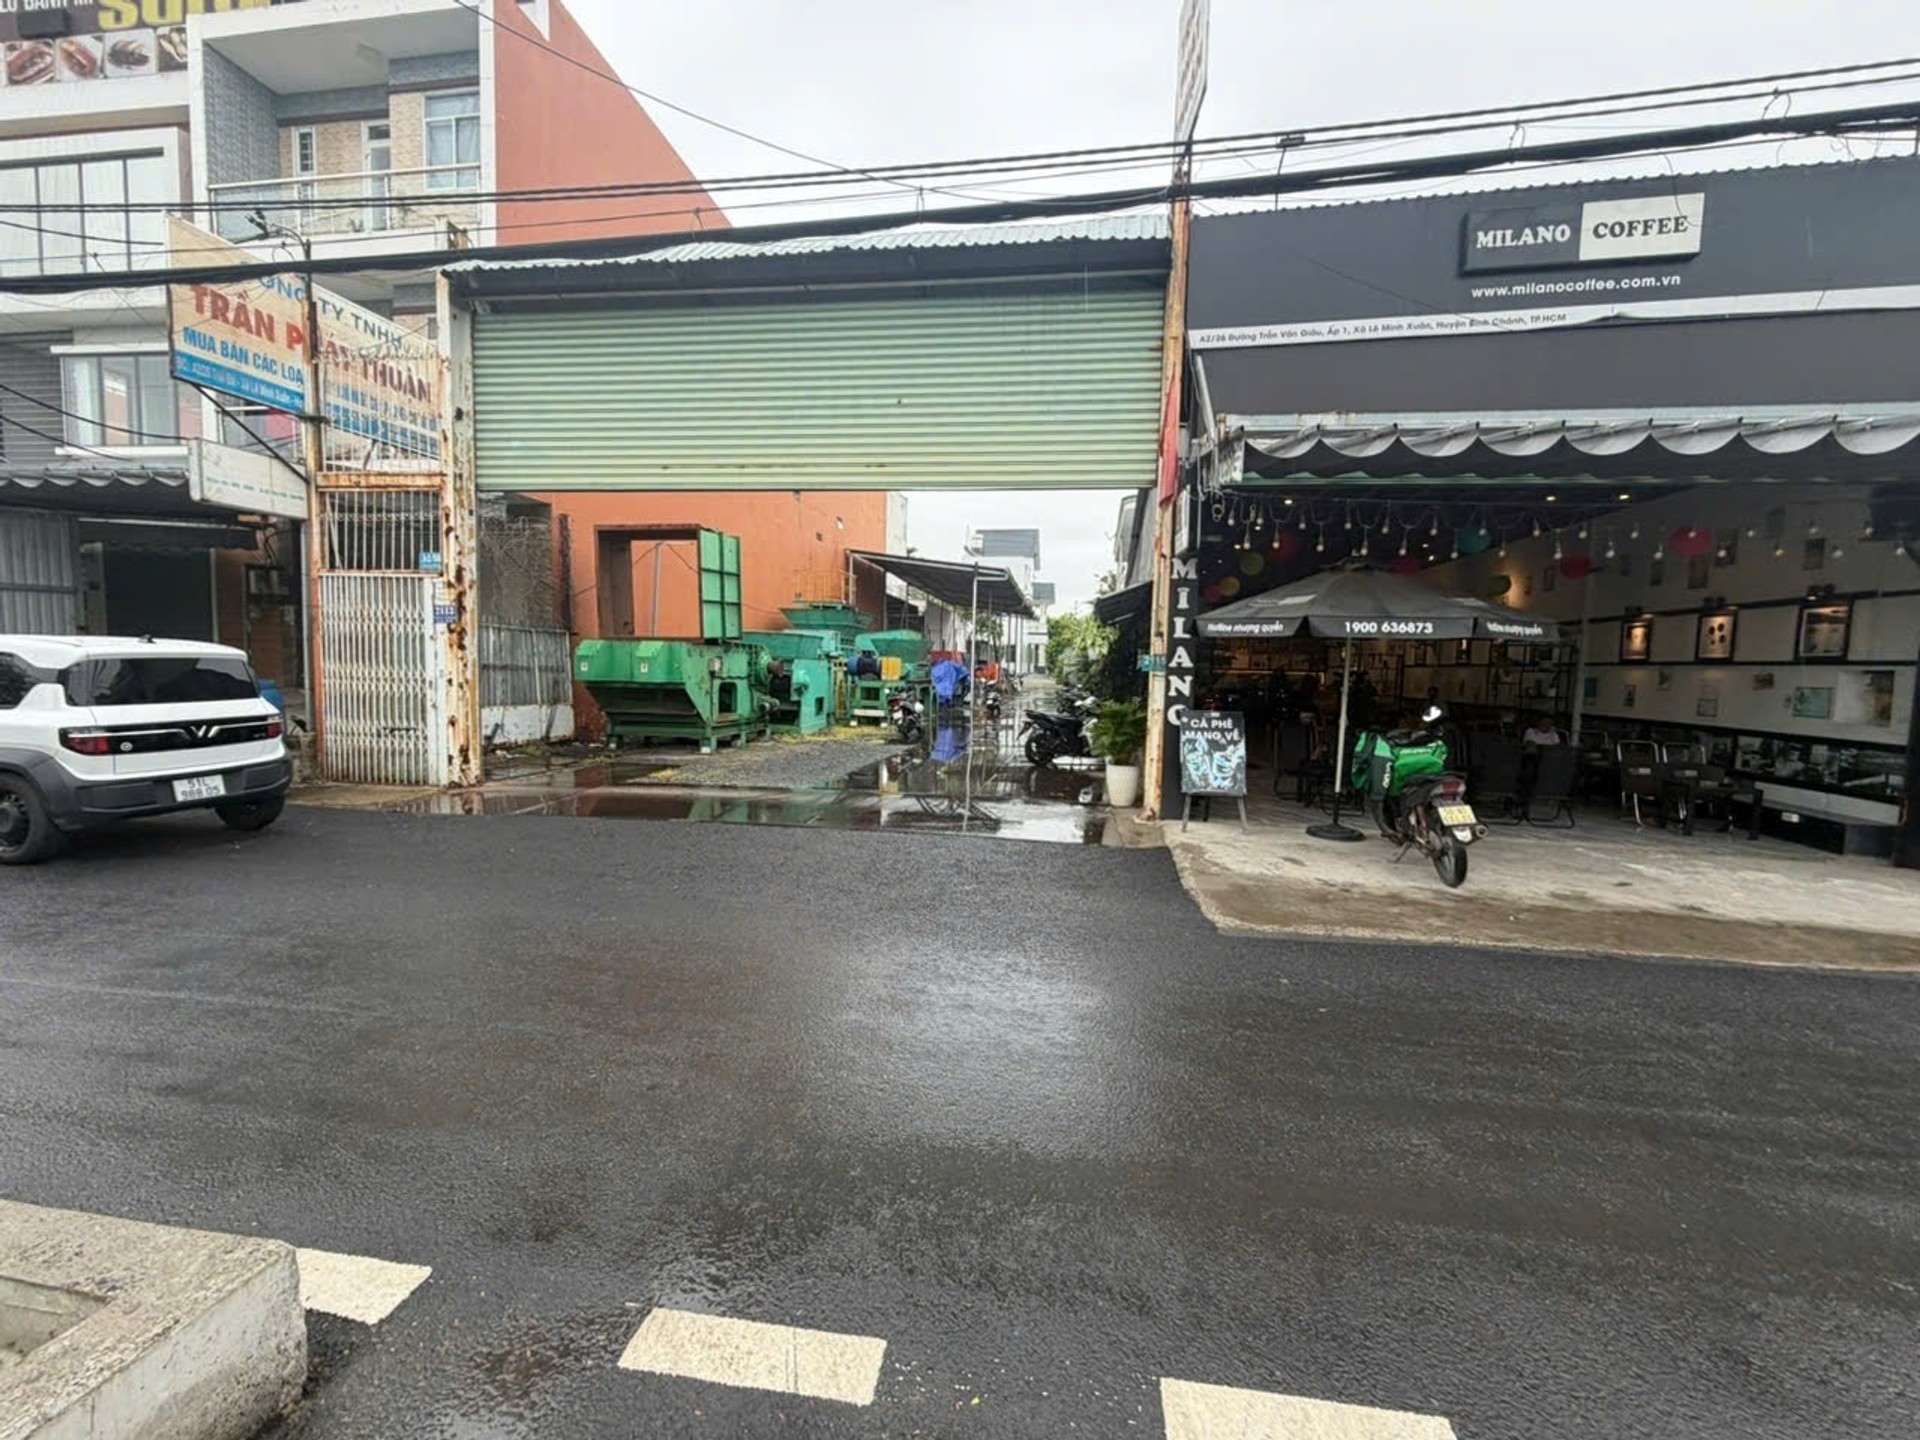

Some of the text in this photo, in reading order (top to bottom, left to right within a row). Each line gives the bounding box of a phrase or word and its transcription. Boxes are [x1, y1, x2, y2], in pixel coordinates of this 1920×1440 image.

[1476, 215, 1689, 248] MILANO COFFEE
[1471, 275, 1682, 298] www.milanocoffee.com.vn
[319, 297, 344, 321] TY
[182, 326, 217, 355] MUA
[1344, 621, 1434, 634] 1900 636873
